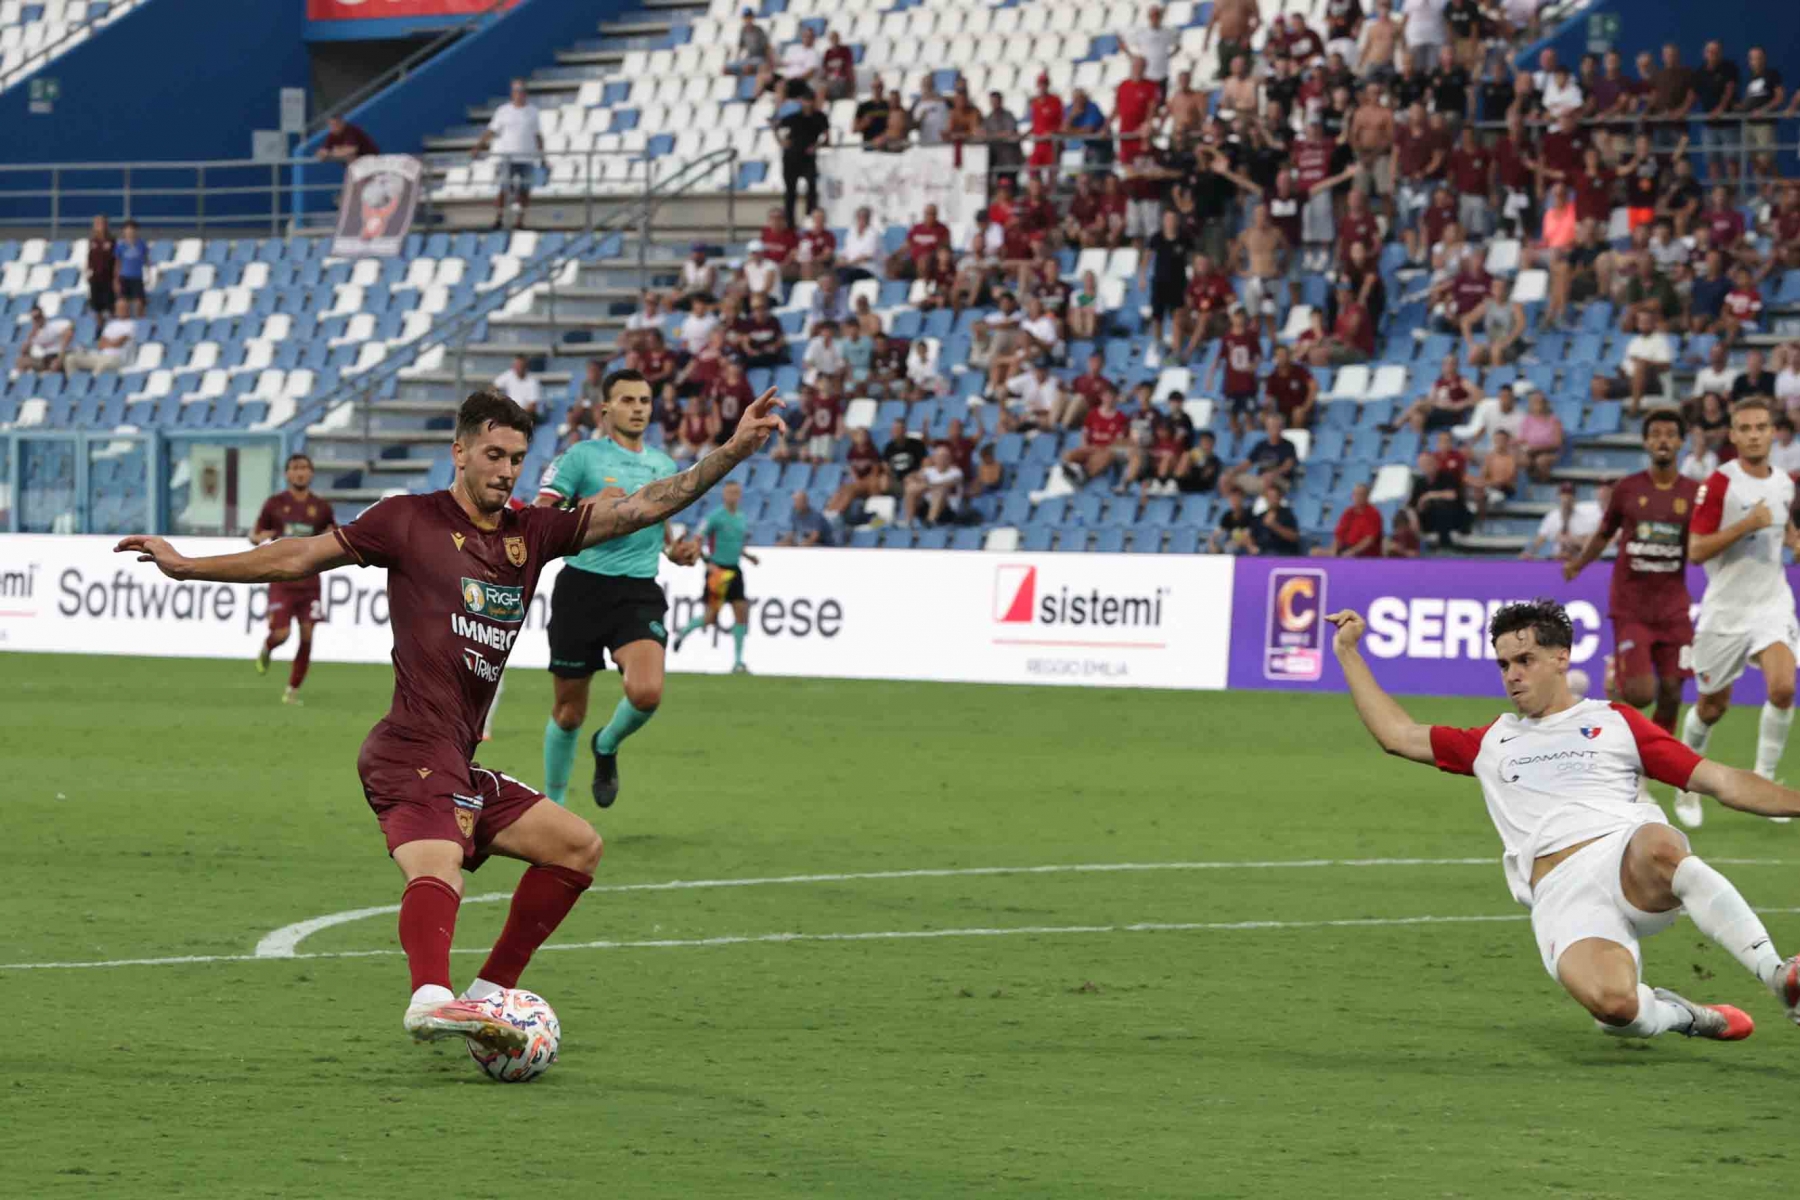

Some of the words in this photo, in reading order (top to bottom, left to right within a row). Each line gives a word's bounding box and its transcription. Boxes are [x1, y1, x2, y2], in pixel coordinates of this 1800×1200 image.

[58, 568, 236, 621] Software
[1039, 586, 1164, 626] sistemi
[1277, 577, 1316, 631] C
[1366, 596, 1538, 660] SERI
[1509, 750, 1599, 767] ADAMANT
